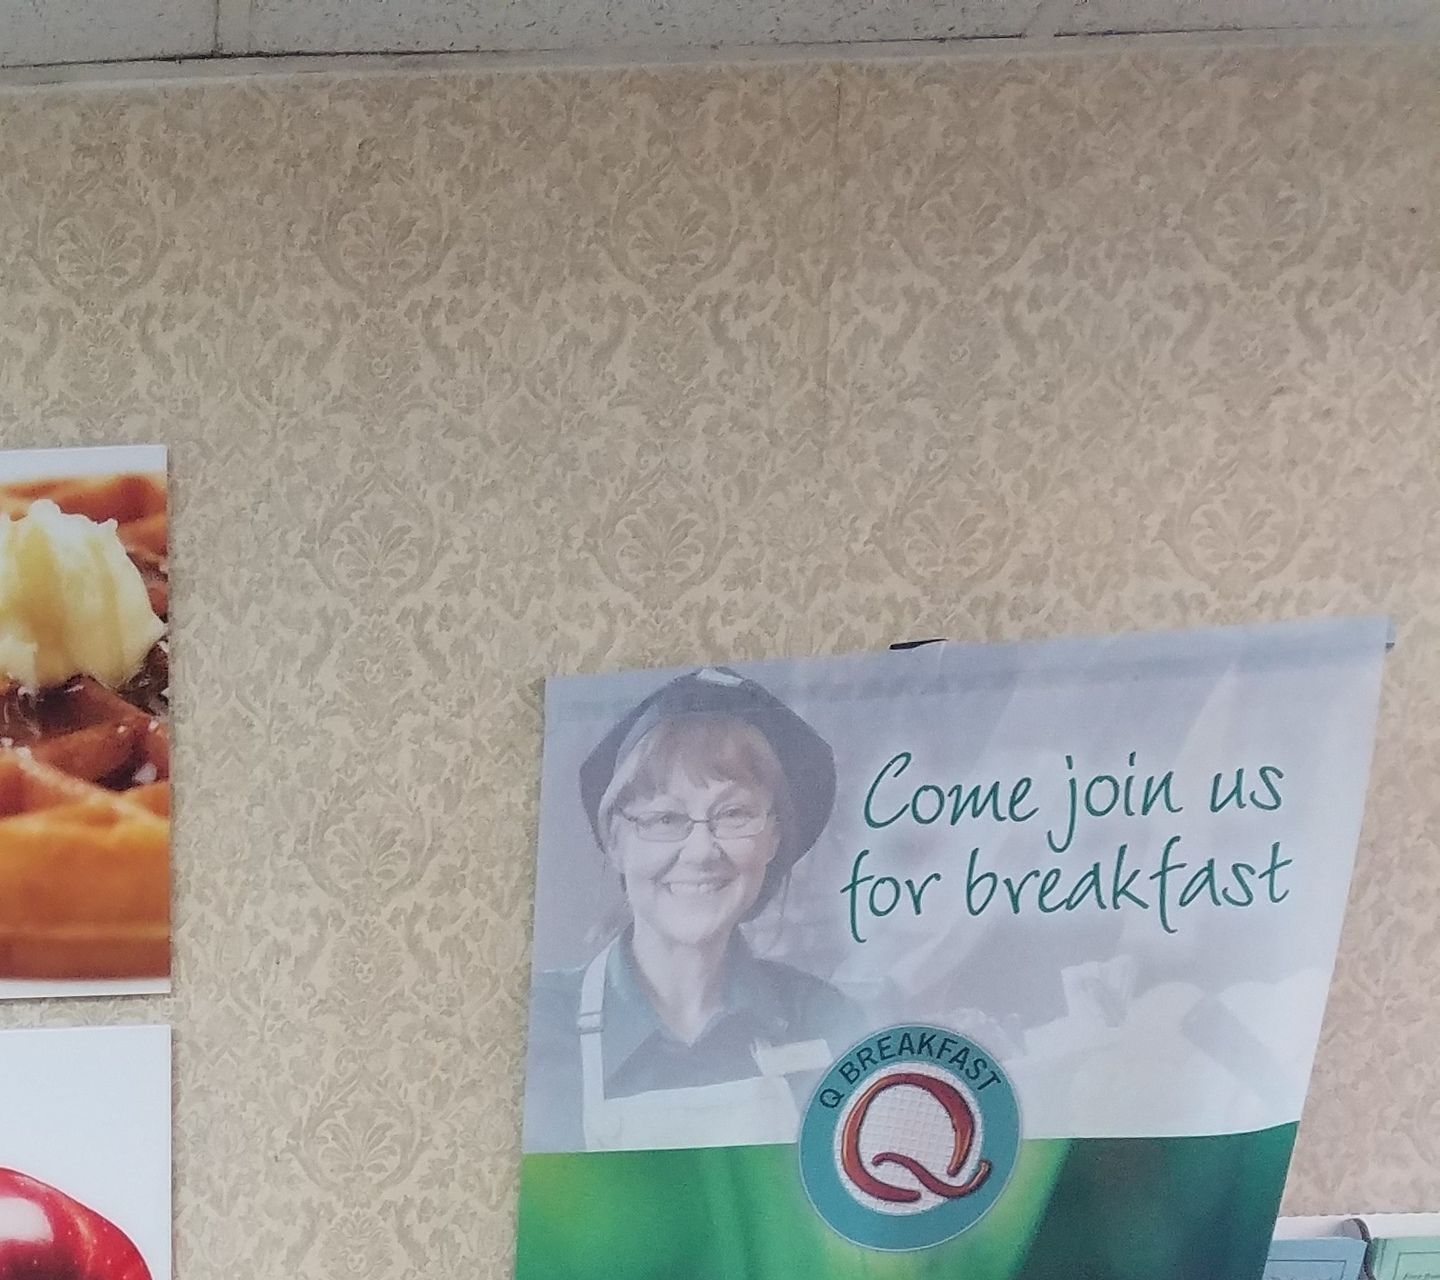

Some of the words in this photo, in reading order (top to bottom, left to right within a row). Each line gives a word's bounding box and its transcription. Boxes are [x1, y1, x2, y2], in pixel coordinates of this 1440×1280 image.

[864, 752, 1040, 828] Come
[1048, 752, 1183, 853] join
[1209, 766, 1285, 815] us
[841, 848, 941, 943] for
[965, 836, 1293, 934] breakfast
[819, 1088, 844, 1109] Q
[838, 1033, 1002, 1093] BREAKFAST
[841, 1072, 992, 1203] Q
